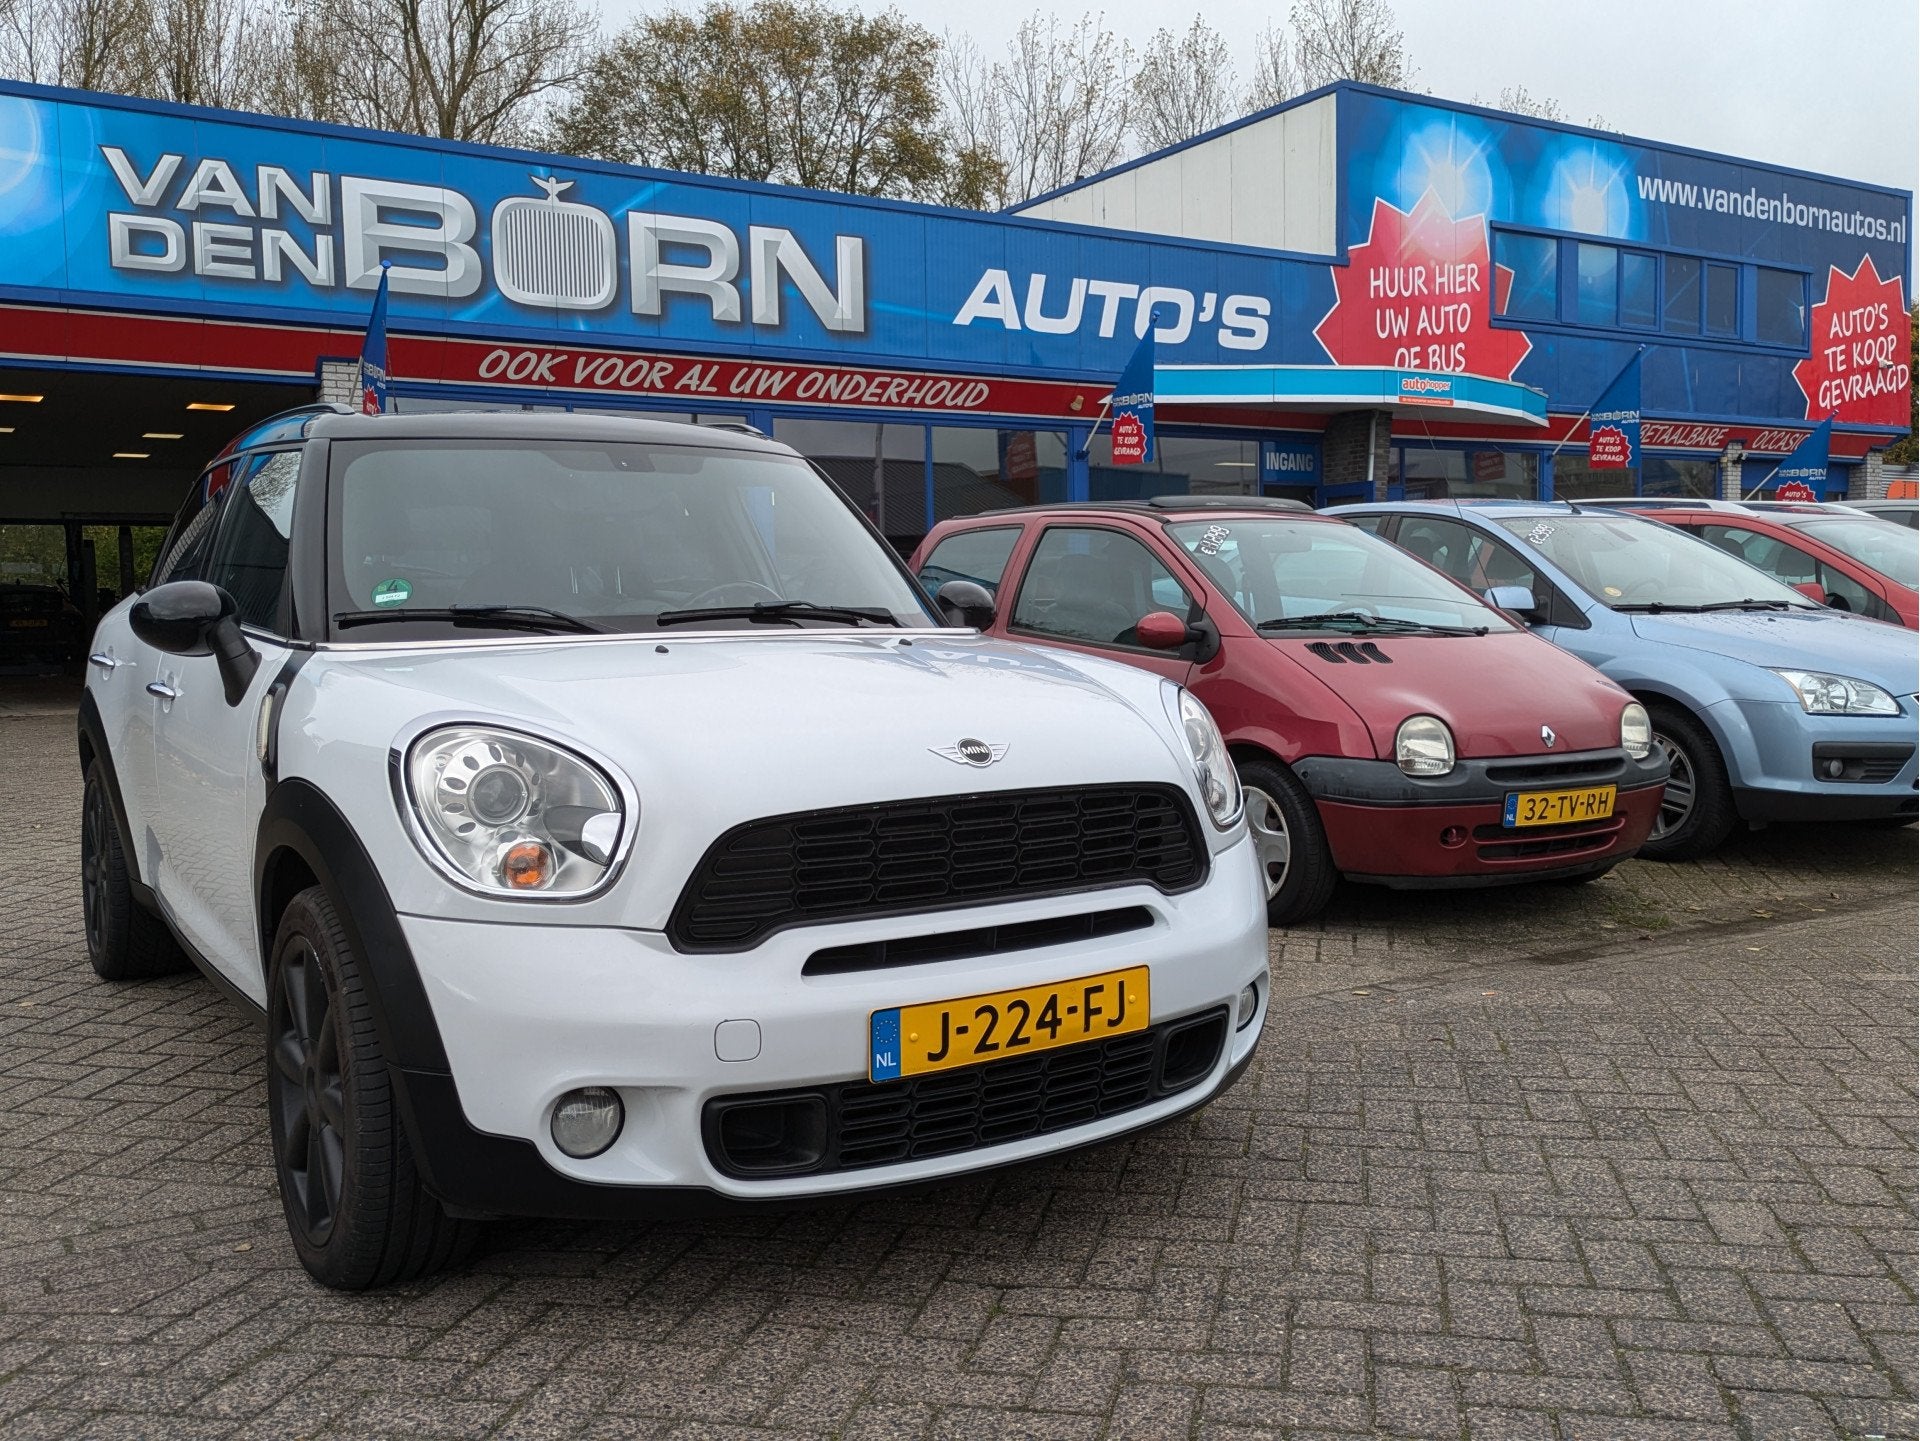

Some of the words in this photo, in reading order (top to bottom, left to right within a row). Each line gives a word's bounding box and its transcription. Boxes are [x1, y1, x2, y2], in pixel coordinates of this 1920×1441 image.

[100, 146, 332, 225] VAN
[1638, 175, 1906, 244] www.vandenbornautos.nl
[108, 212, 335, 287] DEN
[340, 175, 866, 333] BORN
[1370, 266, 1428, 299] HUUR
[1435, 263, 1480, 295] HIER
[953, 268, 1271, 351] AUTO'S
[1376, 306, 1409, 339] UW
[1417, 303, 1471, 336] AUTO
[1829, 303, 1889, 339] AUTO'S
[1394, 346, 1421, 369] OF
[1428, 342, 1466, 372] BUS
[1824, 345, 1847, 372] TE
[1853, 334, 1897, 368] KOOP
[478, 348, 569, 382] OOK
[573, 356, 675, 390] VOOR
[674, 363, 718, 393] AL
[729, 366, 797, 397] UW
[796, 370, 989, 408] ONDERHOUD
[1818, 364, 1909, 409] GEVRAAGD
[1117, 436, 1124, 444] TE
[1124, 436, 1139, 444] KOOP
[1119, 424, 1137, 433] AUTO'S
[1599, 436, 1620, 444] AUTO'S
[1114, 447, 1141, 455] GEVRAAGD
[1266, 452, 1314, 471] INGANG
[1784, 490, 1807, 499] AUTO'S
[961, 745, 989, 755] MINI
[1506, 813, 1515, 821] NL
[1524, 791, 1610, 821] 32-TV-RH
[876, 1051, 897, 1069] NL
[927, 980, 1126, 1062] J-224-FJ
